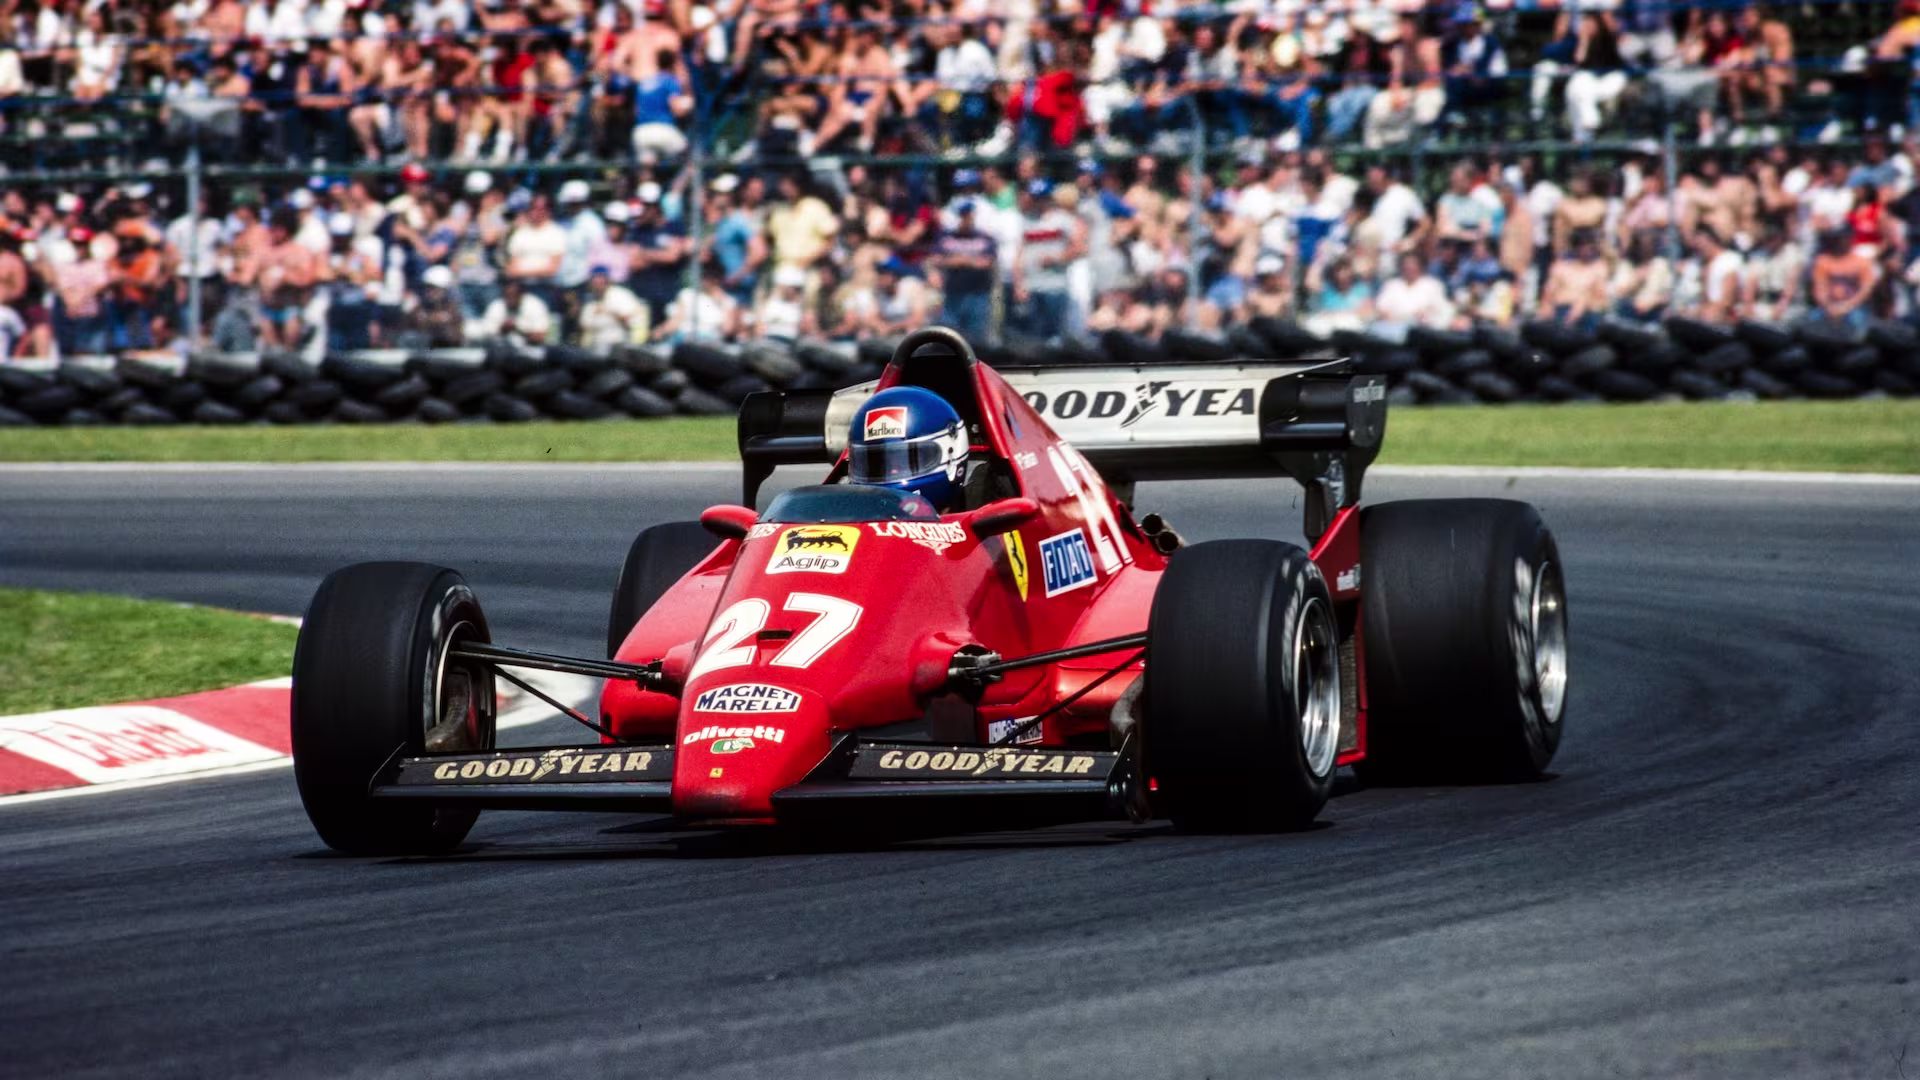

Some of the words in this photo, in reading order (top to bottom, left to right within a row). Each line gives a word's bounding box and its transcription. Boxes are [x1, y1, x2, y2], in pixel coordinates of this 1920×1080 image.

[867, 422, 902, 438] Marlboro
[868, 521, 967, 543] LONGINES
[775, 556, 840, 570] Agip
[1045, 540, 1090, 584] FIAT
[684, 592, 864, 687] 27
[697, 697, 798, 711] MARELLI
[698, 685, 799, 704] MAGNETI
[683, 725, 785, 745] olivetti
